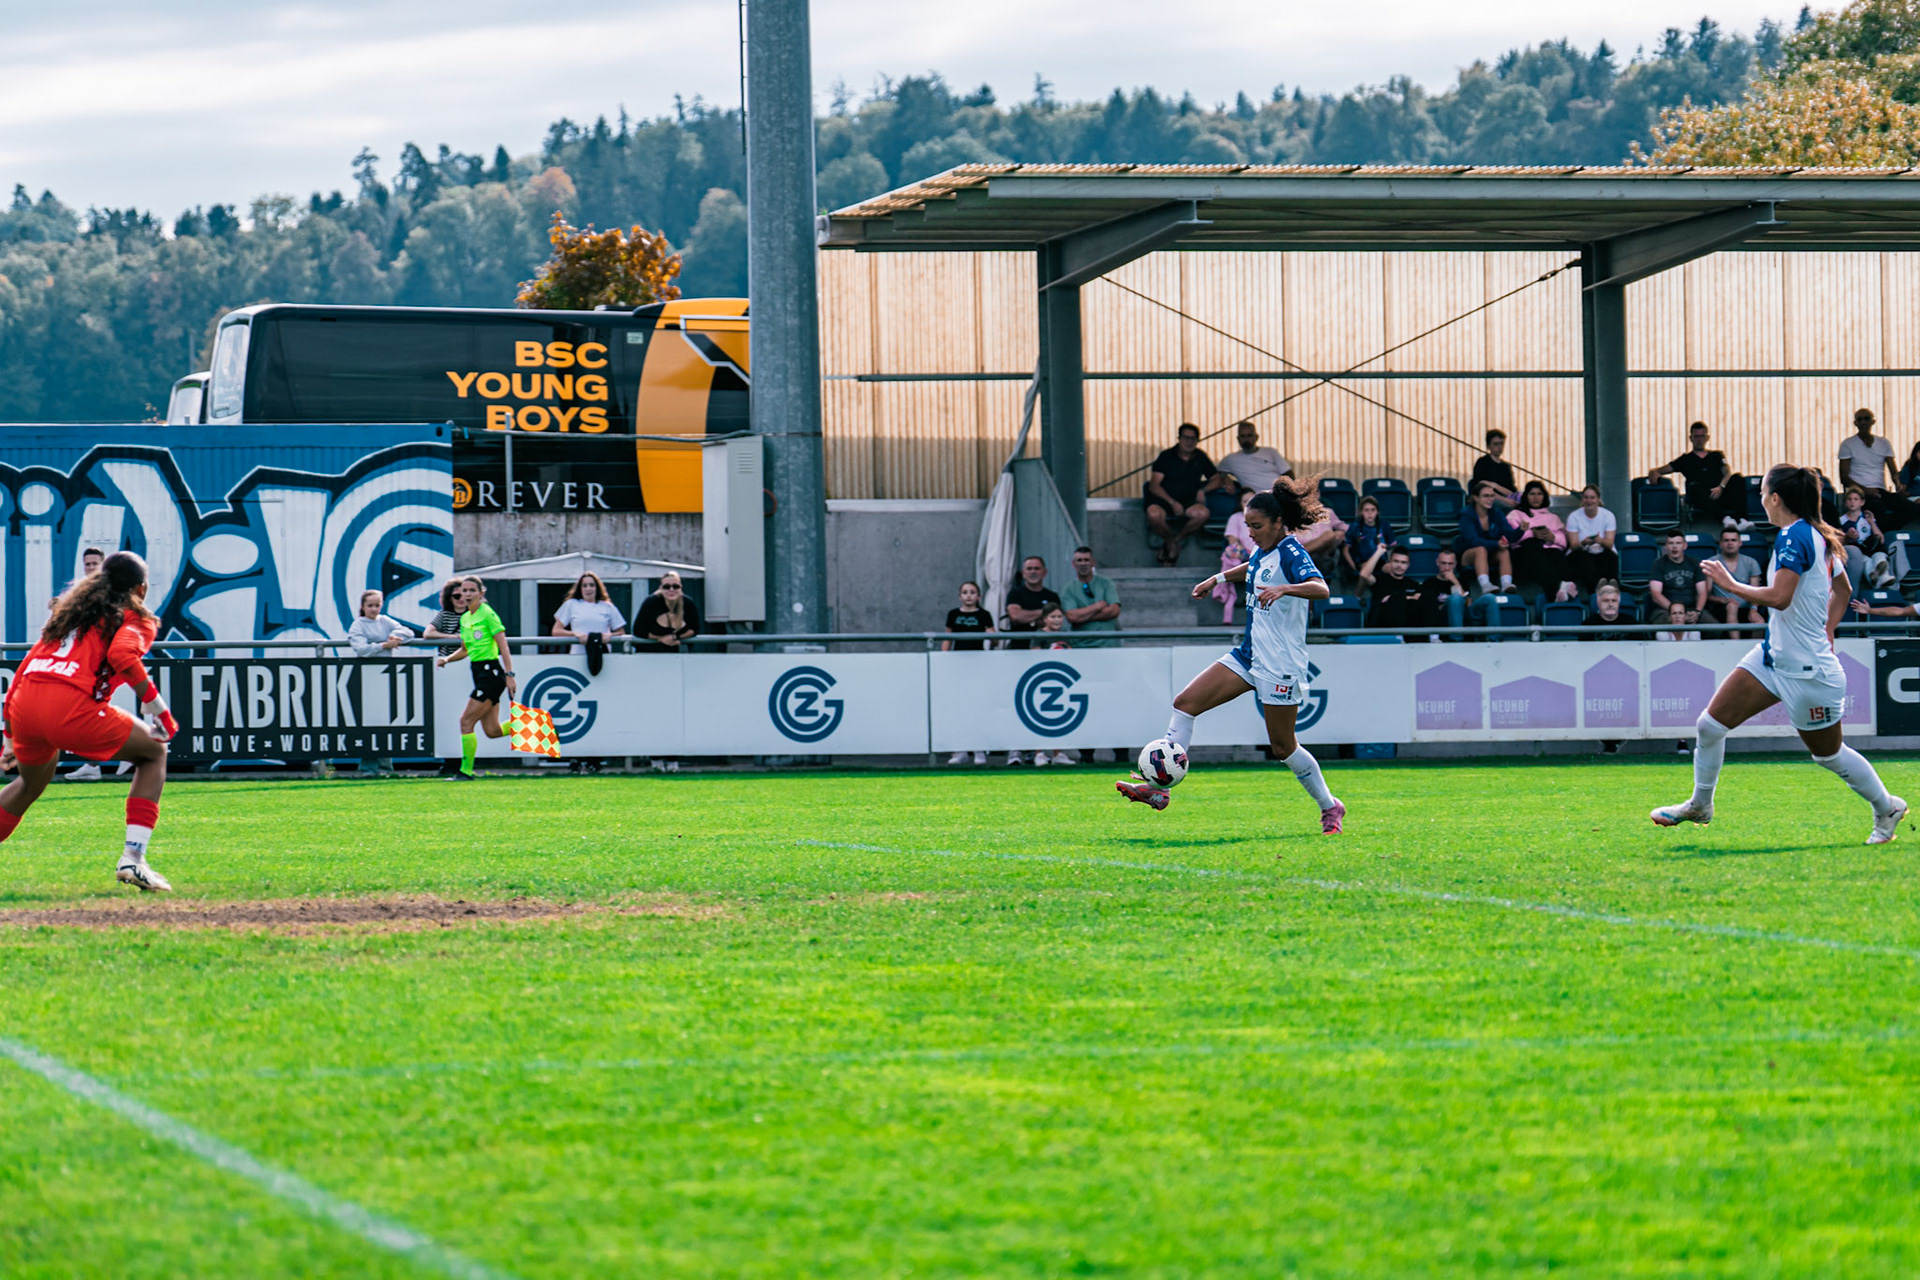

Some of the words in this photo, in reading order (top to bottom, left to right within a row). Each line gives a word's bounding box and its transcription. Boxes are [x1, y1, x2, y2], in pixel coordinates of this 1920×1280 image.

[515, 340, 608, 369] BSC
[446, 371, 608, 401] YOUNG
[486, 404, 610, 433] BOYS
[191, 664, 356, 729] FABRIK
[1585, 698, 1624, 712] NEUHOF
[1652, 697, 1690, 711] NEUHOF
[1417, 700, 1457, 713] NEUHOF
[1491, 699, 1530, 713] NEUHOF
[1809, 706, 1825, 720] 15
[192, 735, 256, 753] MOVE
[279, 733, 348, 752] WORK
[371, 733, 425, 751] LIFE
